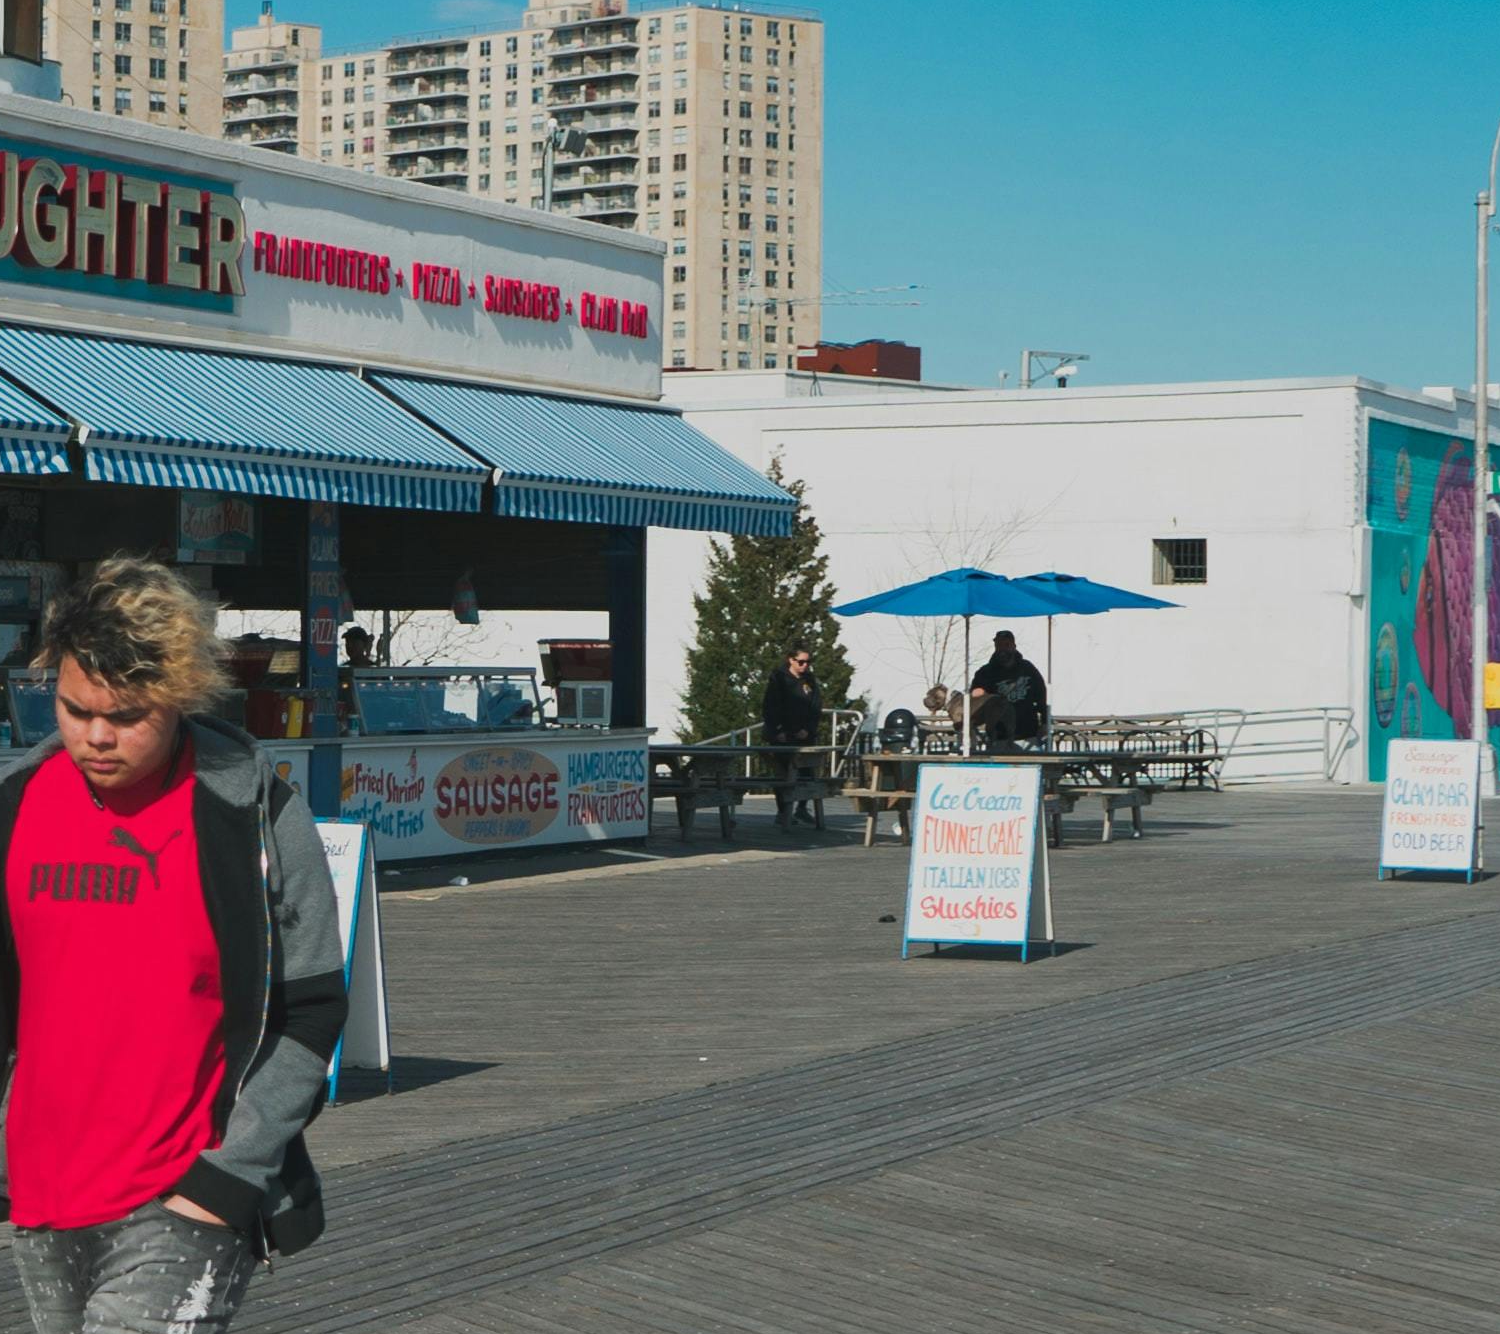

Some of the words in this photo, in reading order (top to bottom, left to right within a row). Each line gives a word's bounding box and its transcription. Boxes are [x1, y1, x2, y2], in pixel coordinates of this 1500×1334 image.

[254, 231, 391, 295] FRANKFURTERS
[412, 262, 461, 306] PIZZA
[484, 274, 561, 323] SAUSAGES
[580, 292, 618, 333] CLAM
[621, 300, 648, 339] BAR
[354, 763, 384, 795] Fried
[386, 772, 425, 804] Shrimp
[568, 750, 645, 787] HAMBURGERS
[436, 773, 559, 818] SAUSAGE
[568, 788, 645, 827] FRANKFURTERS
[929, 783, 960, 810] Ice
[963, 784, 1022, 811] Cream
[1391, 778, 1433, 807] CLAM
[1437, 781, 1469, 807] BAR
[396, 808, 425, 839] Fries
[923, 815, 985, 854] FUNNEL
[987, 816, 1026, 855] CAKE
[1390, 811, 1432, 826] FRENCH
[1435, 813, 1467, 827] FRIES
[1392, 832, 1426, 850] COLD
[1430, 834, 1465, 851] BEER
[27, 862, 140, 905] PUMA
[923, 866, 985, 889] ITALIAN
[989, 866, 1021, 889] ICES
[920, 895, 1018, 920] Slushies
